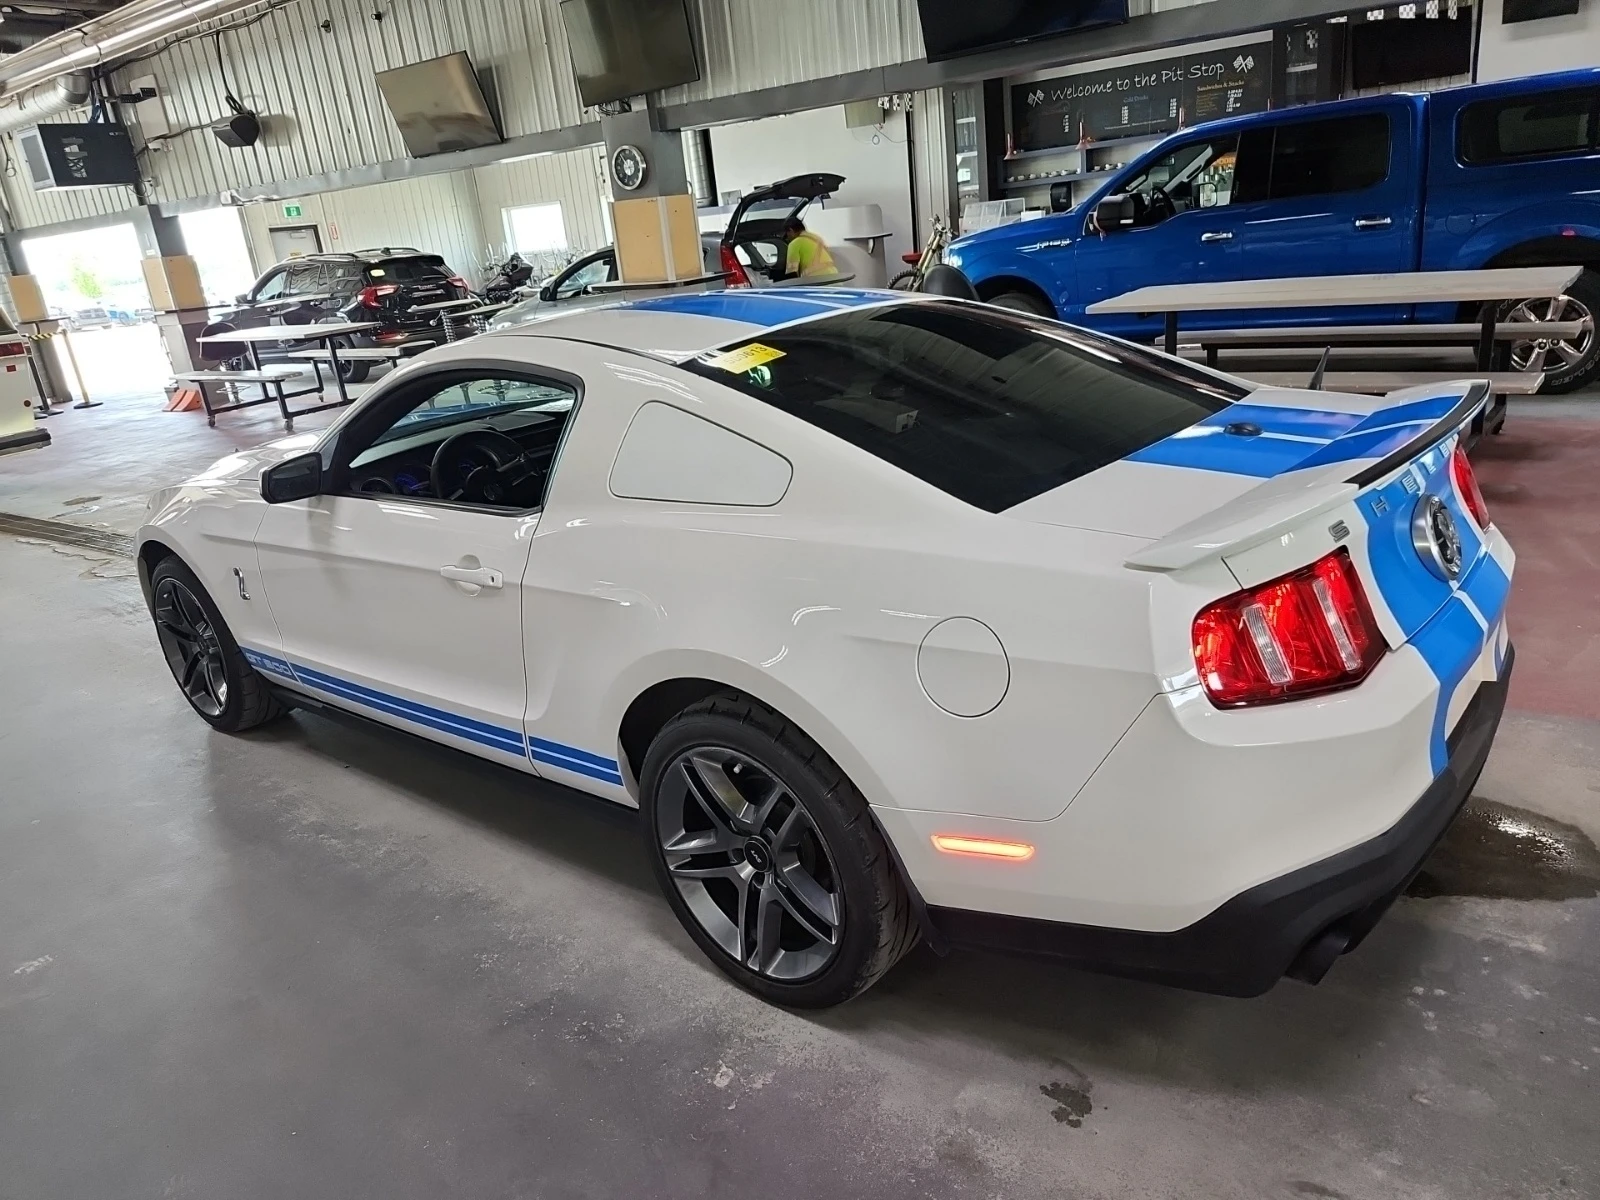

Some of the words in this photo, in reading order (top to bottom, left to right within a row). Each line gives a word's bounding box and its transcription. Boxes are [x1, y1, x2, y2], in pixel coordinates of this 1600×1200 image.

[1051, 80, 1113, 101] Welcome
[1117, 78, 1130, 91] to
[1134, 72, 1157, 88] the
[1161, 66, 1184, 83] Pit
[1187, 63, 1225, 80] Stop
